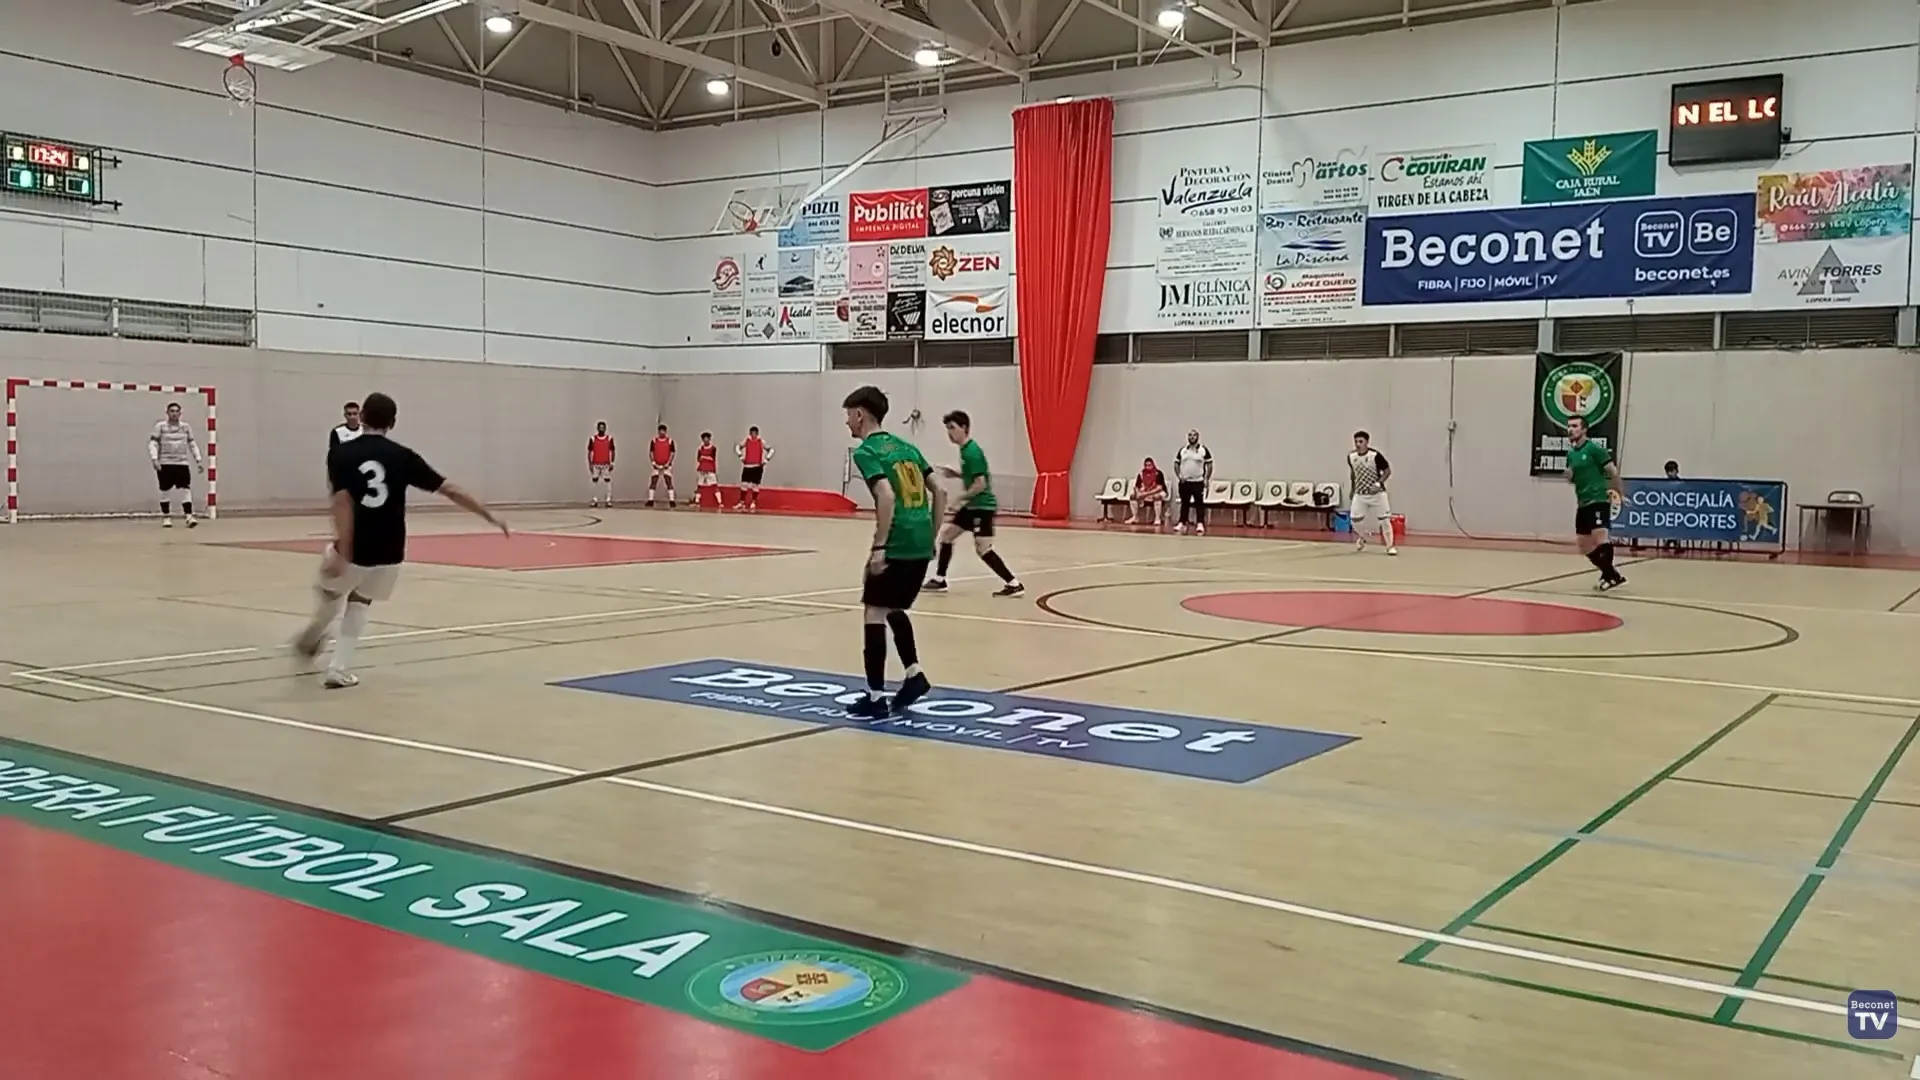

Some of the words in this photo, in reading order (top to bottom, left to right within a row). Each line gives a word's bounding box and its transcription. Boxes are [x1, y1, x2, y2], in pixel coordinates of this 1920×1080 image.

[1709, 101, 1738, 122] EL
[1180, 167, 1223, 177] PINTURA
[1406, 157, 1487, 177] COVIRAN
[1162, 175, 1253, 206] Valenzuela
[1424, 175, 1464, 189] Estamos
[1556, 179, 1581, 190] CAJA
[1583, 176, 1621, 187] RURAL
[951, 187, 982, 201] porcuna
[1377, 193, 1415, 208] VIRGEN
[1417, 192, 1431, 205] DE
[1433, 191, 1447, 204] LA
[1449, 188, 1489, 203] CABEZA
[1769, 186, 1822, 212] Raúl
[1826, 180, 1899, 209] Alcalá
[854, 200, 924, 223] Publikit
[1265, 216, 1285, 229] Bar
[1297, 211, 1363, 227] Restaurante
[892, 222, 919, 231] DIGITAL
[1641, 221, 1679, 231] Beconet
[1694, 221, 1732, 244] Be
[1380, 218, 1605, 269] Beconet
[1645, 232, 1674, 248] TV
[958, 255, 1000, 272] ZEN
[1276, 254, 1290, 265] La
[1295, 252, 1350, 265] Piscina
[1635, 267, 1731, 283] beconet.es
[1823, 264, 1883, 278] TORRES
[1197, 278, 1251, 293] CLÍNICA
[1418, 278, 1453, 291] FIBRA
[1460, 276, 1487, 289] FIJO
[1494, 274, 1533, 288] MÓVIL
[1541, 275, 1558, 286] TV
[1159, 284, 1191, 311] JM
[1197, 294, 1250, 307] DENTAL
[932, 312, 1005, 334] elecnor
[357, 460, 390, 509] 3
[892, 461, 925, 509] 10
[1632, 490, 1735, 509] CONCEJALÍA
[1629, 512, 1651, 527] DE
[1654, 513, 1738, 530] DEPORTES
[689, 690, 784, 710] FIBRA
[1034, 736, 1090, 750] TV
[98, 805, 434, 902] FÚTBOL
[408, 882, 712, 979] SALA
